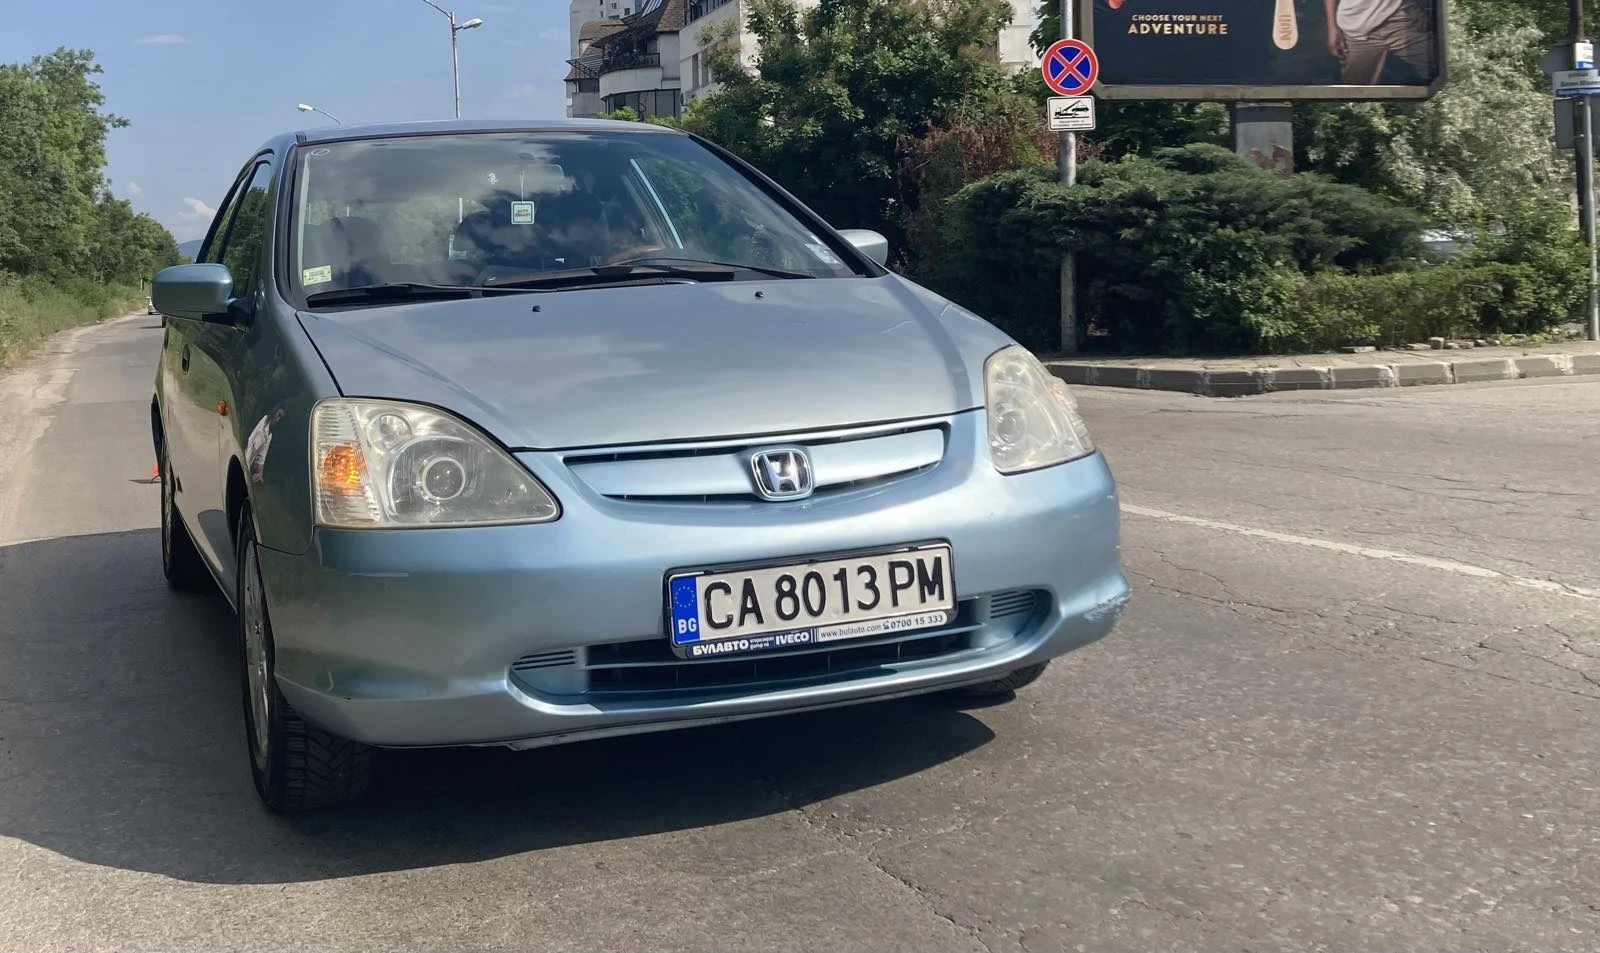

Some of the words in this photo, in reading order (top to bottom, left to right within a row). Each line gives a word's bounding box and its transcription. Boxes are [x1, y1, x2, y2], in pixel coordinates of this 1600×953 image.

[1131, 14, 1170, 22] CHOOSE
[1172, 14, 1198, 22] YOUR
[1199, 14, 1224, 22] NEXT
[1127, 23, 1229, 35] ADVENTURE
[704, 578, 765, 630] CA
[775, 565, 881, 622] 8013
[888, 556, 945, 608] PM
[677, 618, 698, 635] BG
[820, 625, 882, 639] www.bulauto.com
[890, 620, 912, 630] 0700
[915, 617, 925, 625] 15
[928, 614, 943, 624] 333
[692, 639, 749, 656] БУЛАВТО
[775, 632, 810, 646] IVECO
